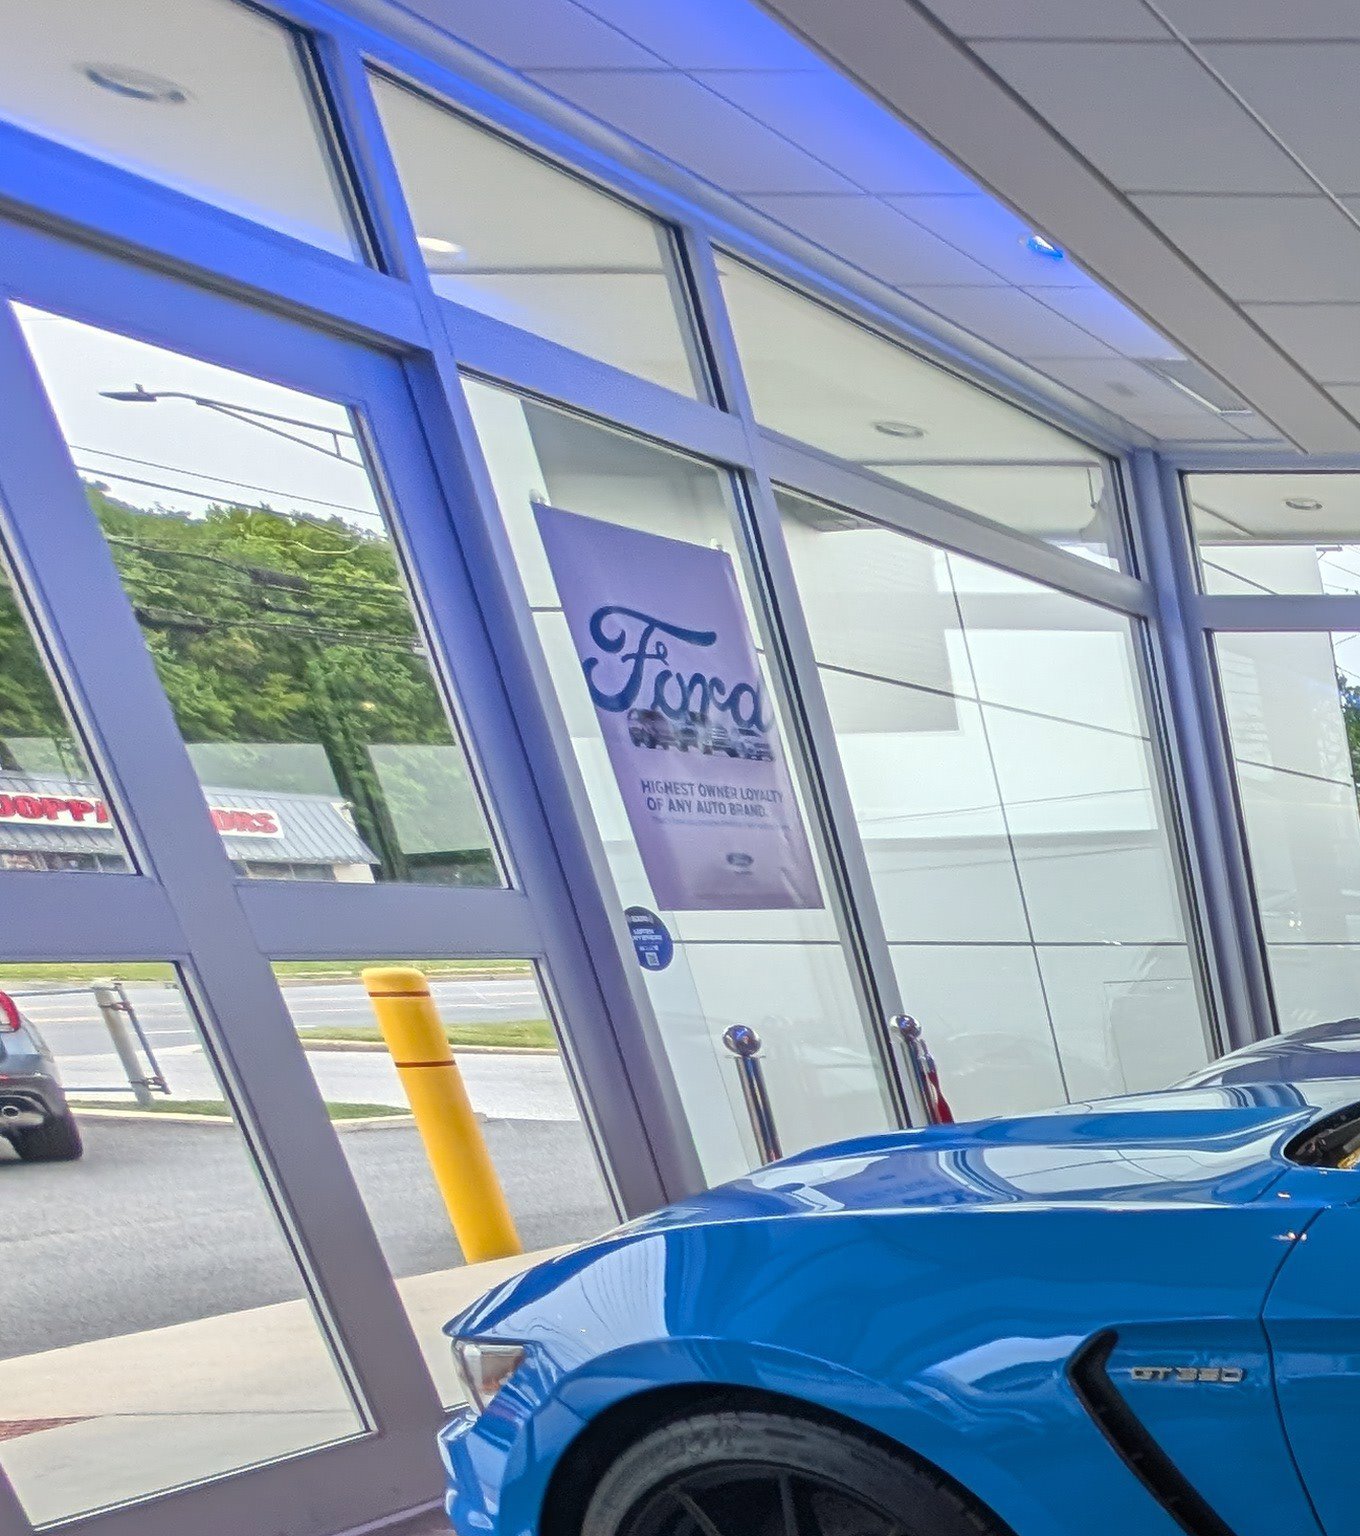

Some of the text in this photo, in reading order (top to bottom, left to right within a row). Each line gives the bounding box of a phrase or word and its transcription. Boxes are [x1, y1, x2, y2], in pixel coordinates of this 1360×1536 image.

[583, 605, 772, 733] Ford
[640, 779, 783, 803] HIGHEST OWNER LOYALTY
[646, 797, 663, 811] OF
[668, 799, 694, 814] ANY
[697, 800, 726, 816] AUTO
